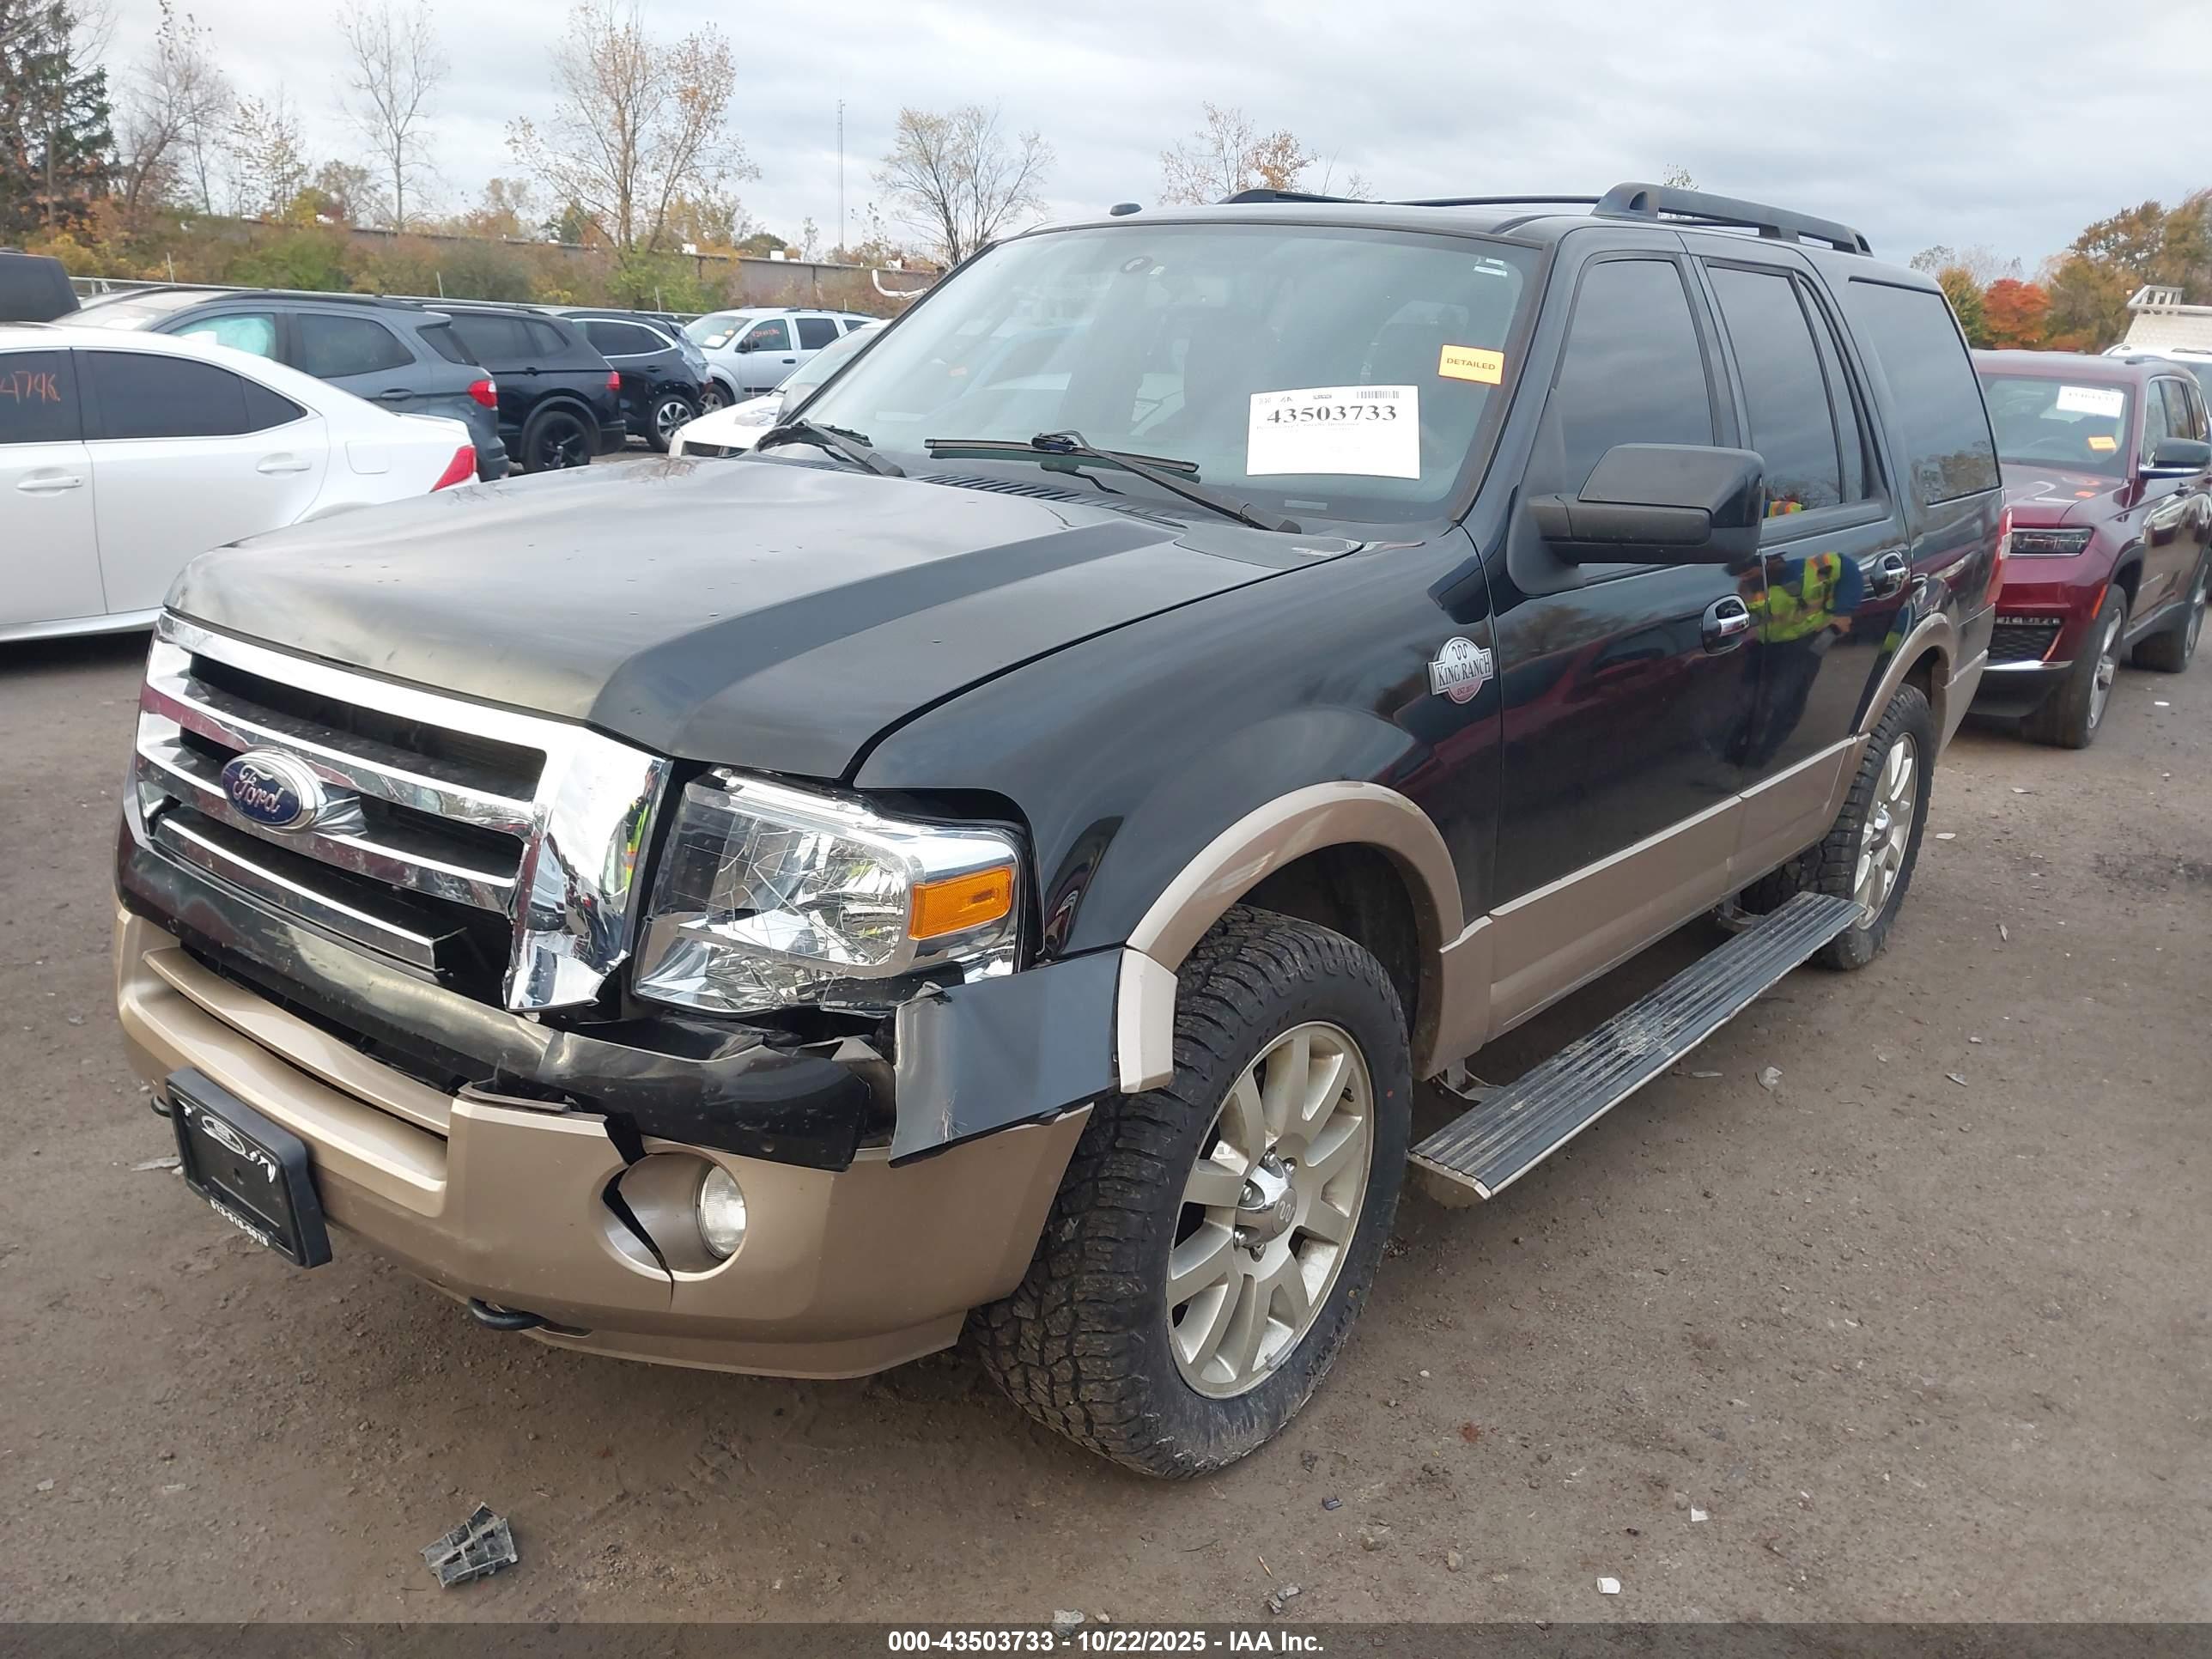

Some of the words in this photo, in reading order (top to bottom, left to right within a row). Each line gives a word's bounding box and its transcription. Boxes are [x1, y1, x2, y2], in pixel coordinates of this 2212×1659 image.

[1446, 357, 1496, 370] DETAILED
[1267, 404, 1397, 424] 43503733
[1437, 665, 1460, 686] KING
[1462, 654, 1491, 679] RANCH
[232, 764, 284, 814] Ford
